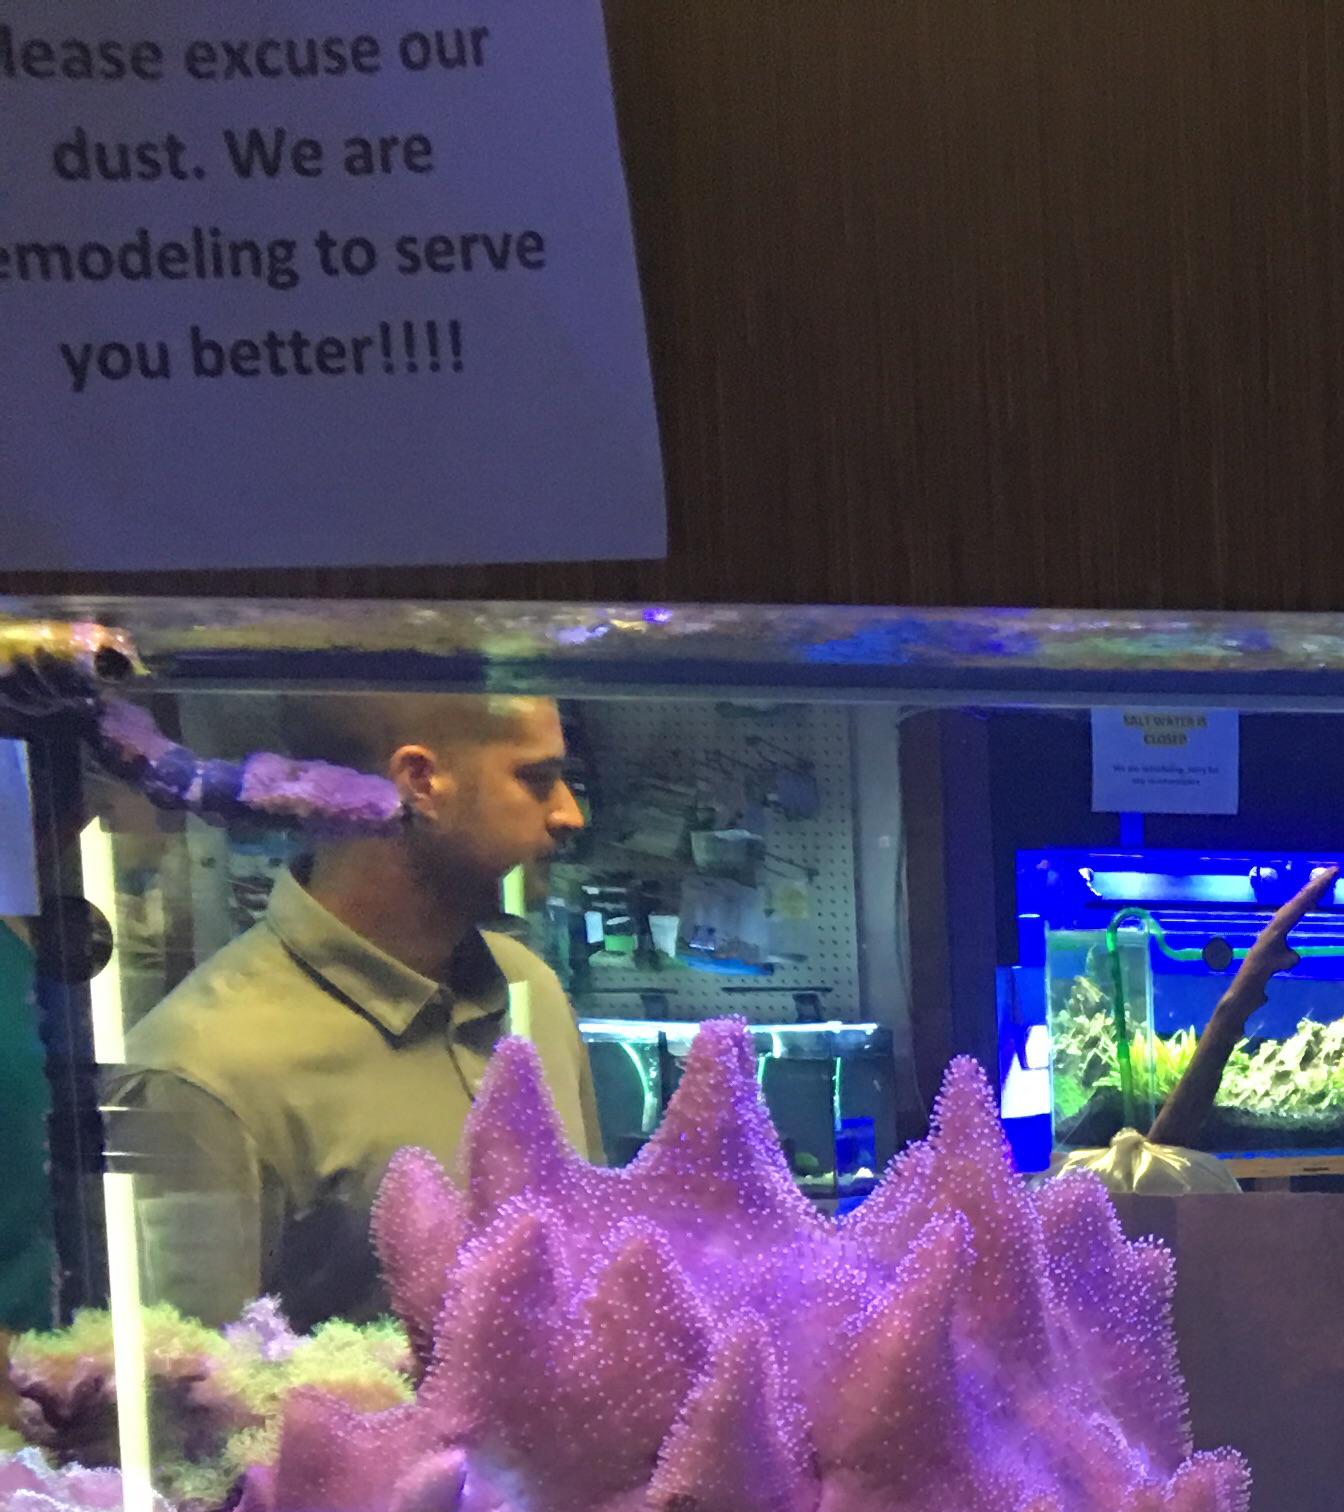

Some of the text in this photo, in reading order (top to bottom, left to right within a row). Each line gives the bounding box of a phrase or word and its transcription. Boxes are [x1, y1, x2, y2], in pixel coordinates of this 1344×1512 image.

[185, 35, 382, 80] excuse
[400, 26, 490, 71] our
[53, 125, 434, 181] dust. We are
[314, 229, 377, 277] to
[395, 229, 547, 274] serve
[59, 319, 464, 393] you better!!!!
[1143, 733, 1188, 745] CLOSED
[1153, 715, 1194, 728] WATER
